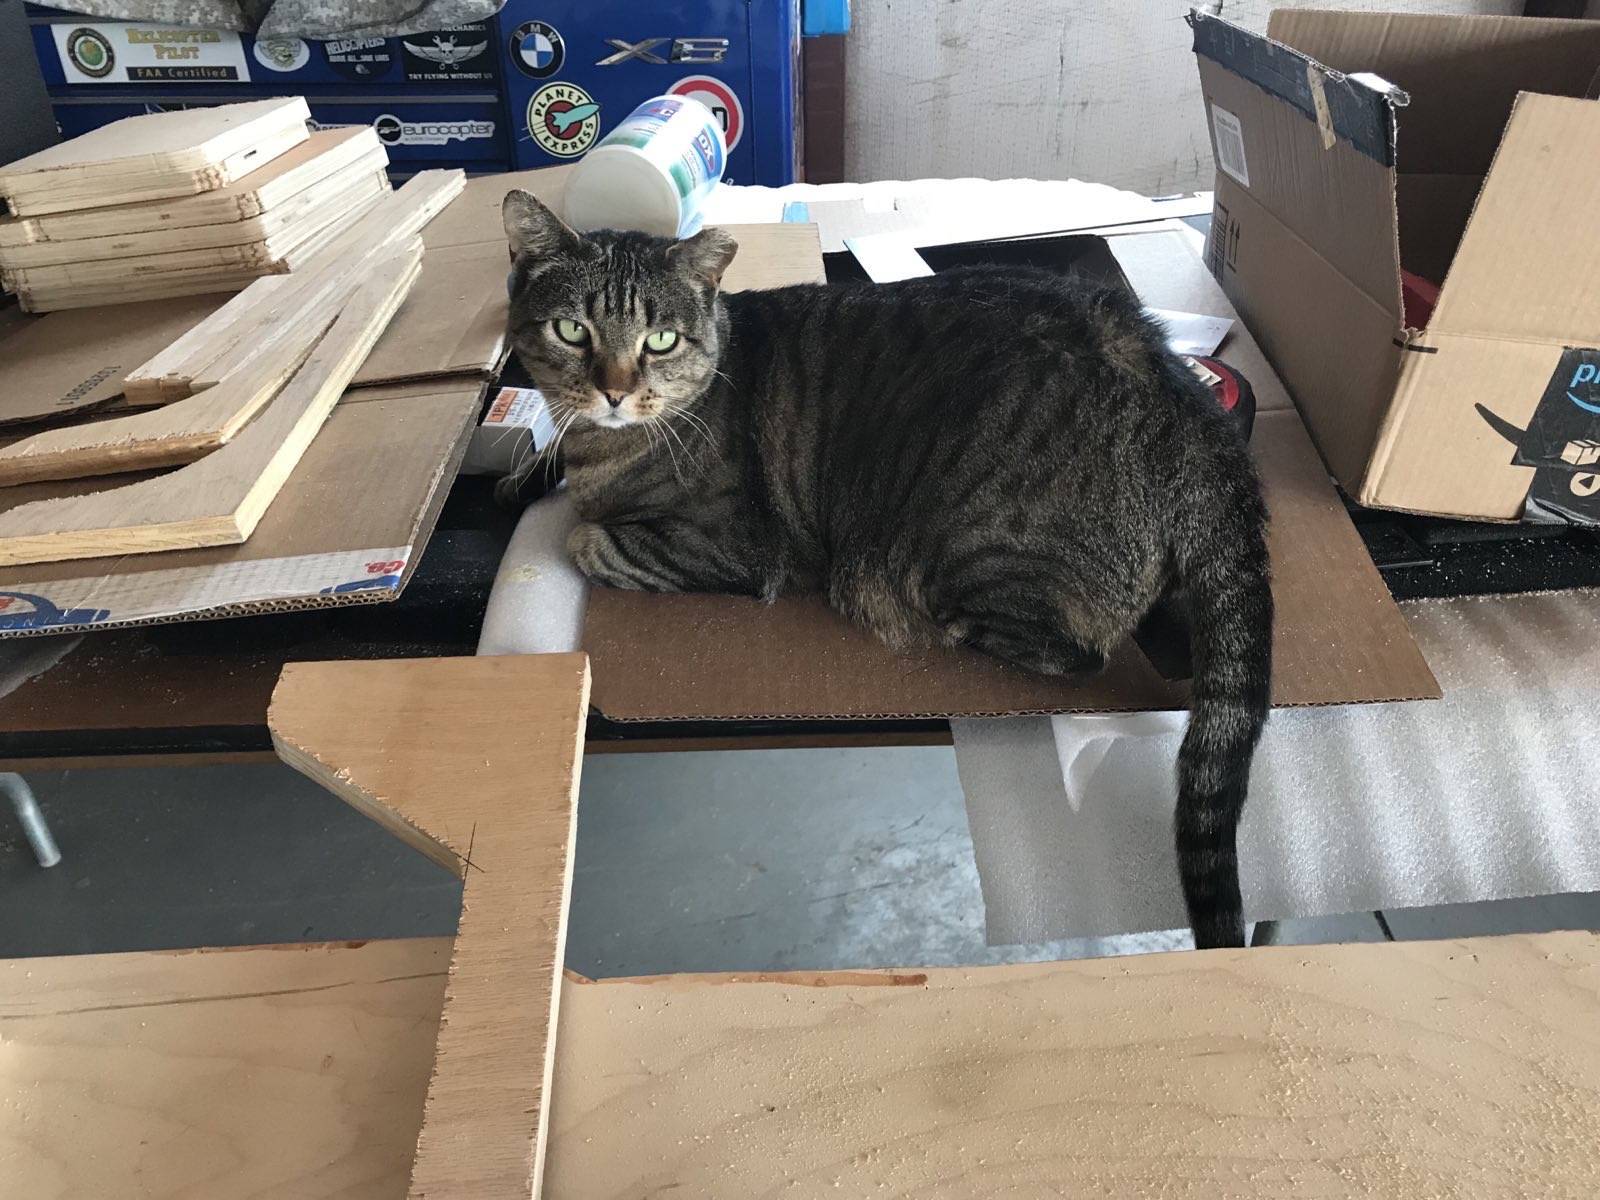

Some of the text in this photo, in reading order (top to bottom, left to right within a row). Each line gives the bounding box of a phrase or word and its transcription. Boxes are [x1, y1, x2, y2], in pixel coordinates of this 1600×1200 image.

[514, 23, 559, 44] BMW
[136, 67, 228, 78] FAA Certified
[450, 72, 482, 80] WITHOUT
[534, 88, 583, 117] PLANET
[403, 122, 493, 138] eurocopter
[543, 121, 594, 152] EXPRESS
